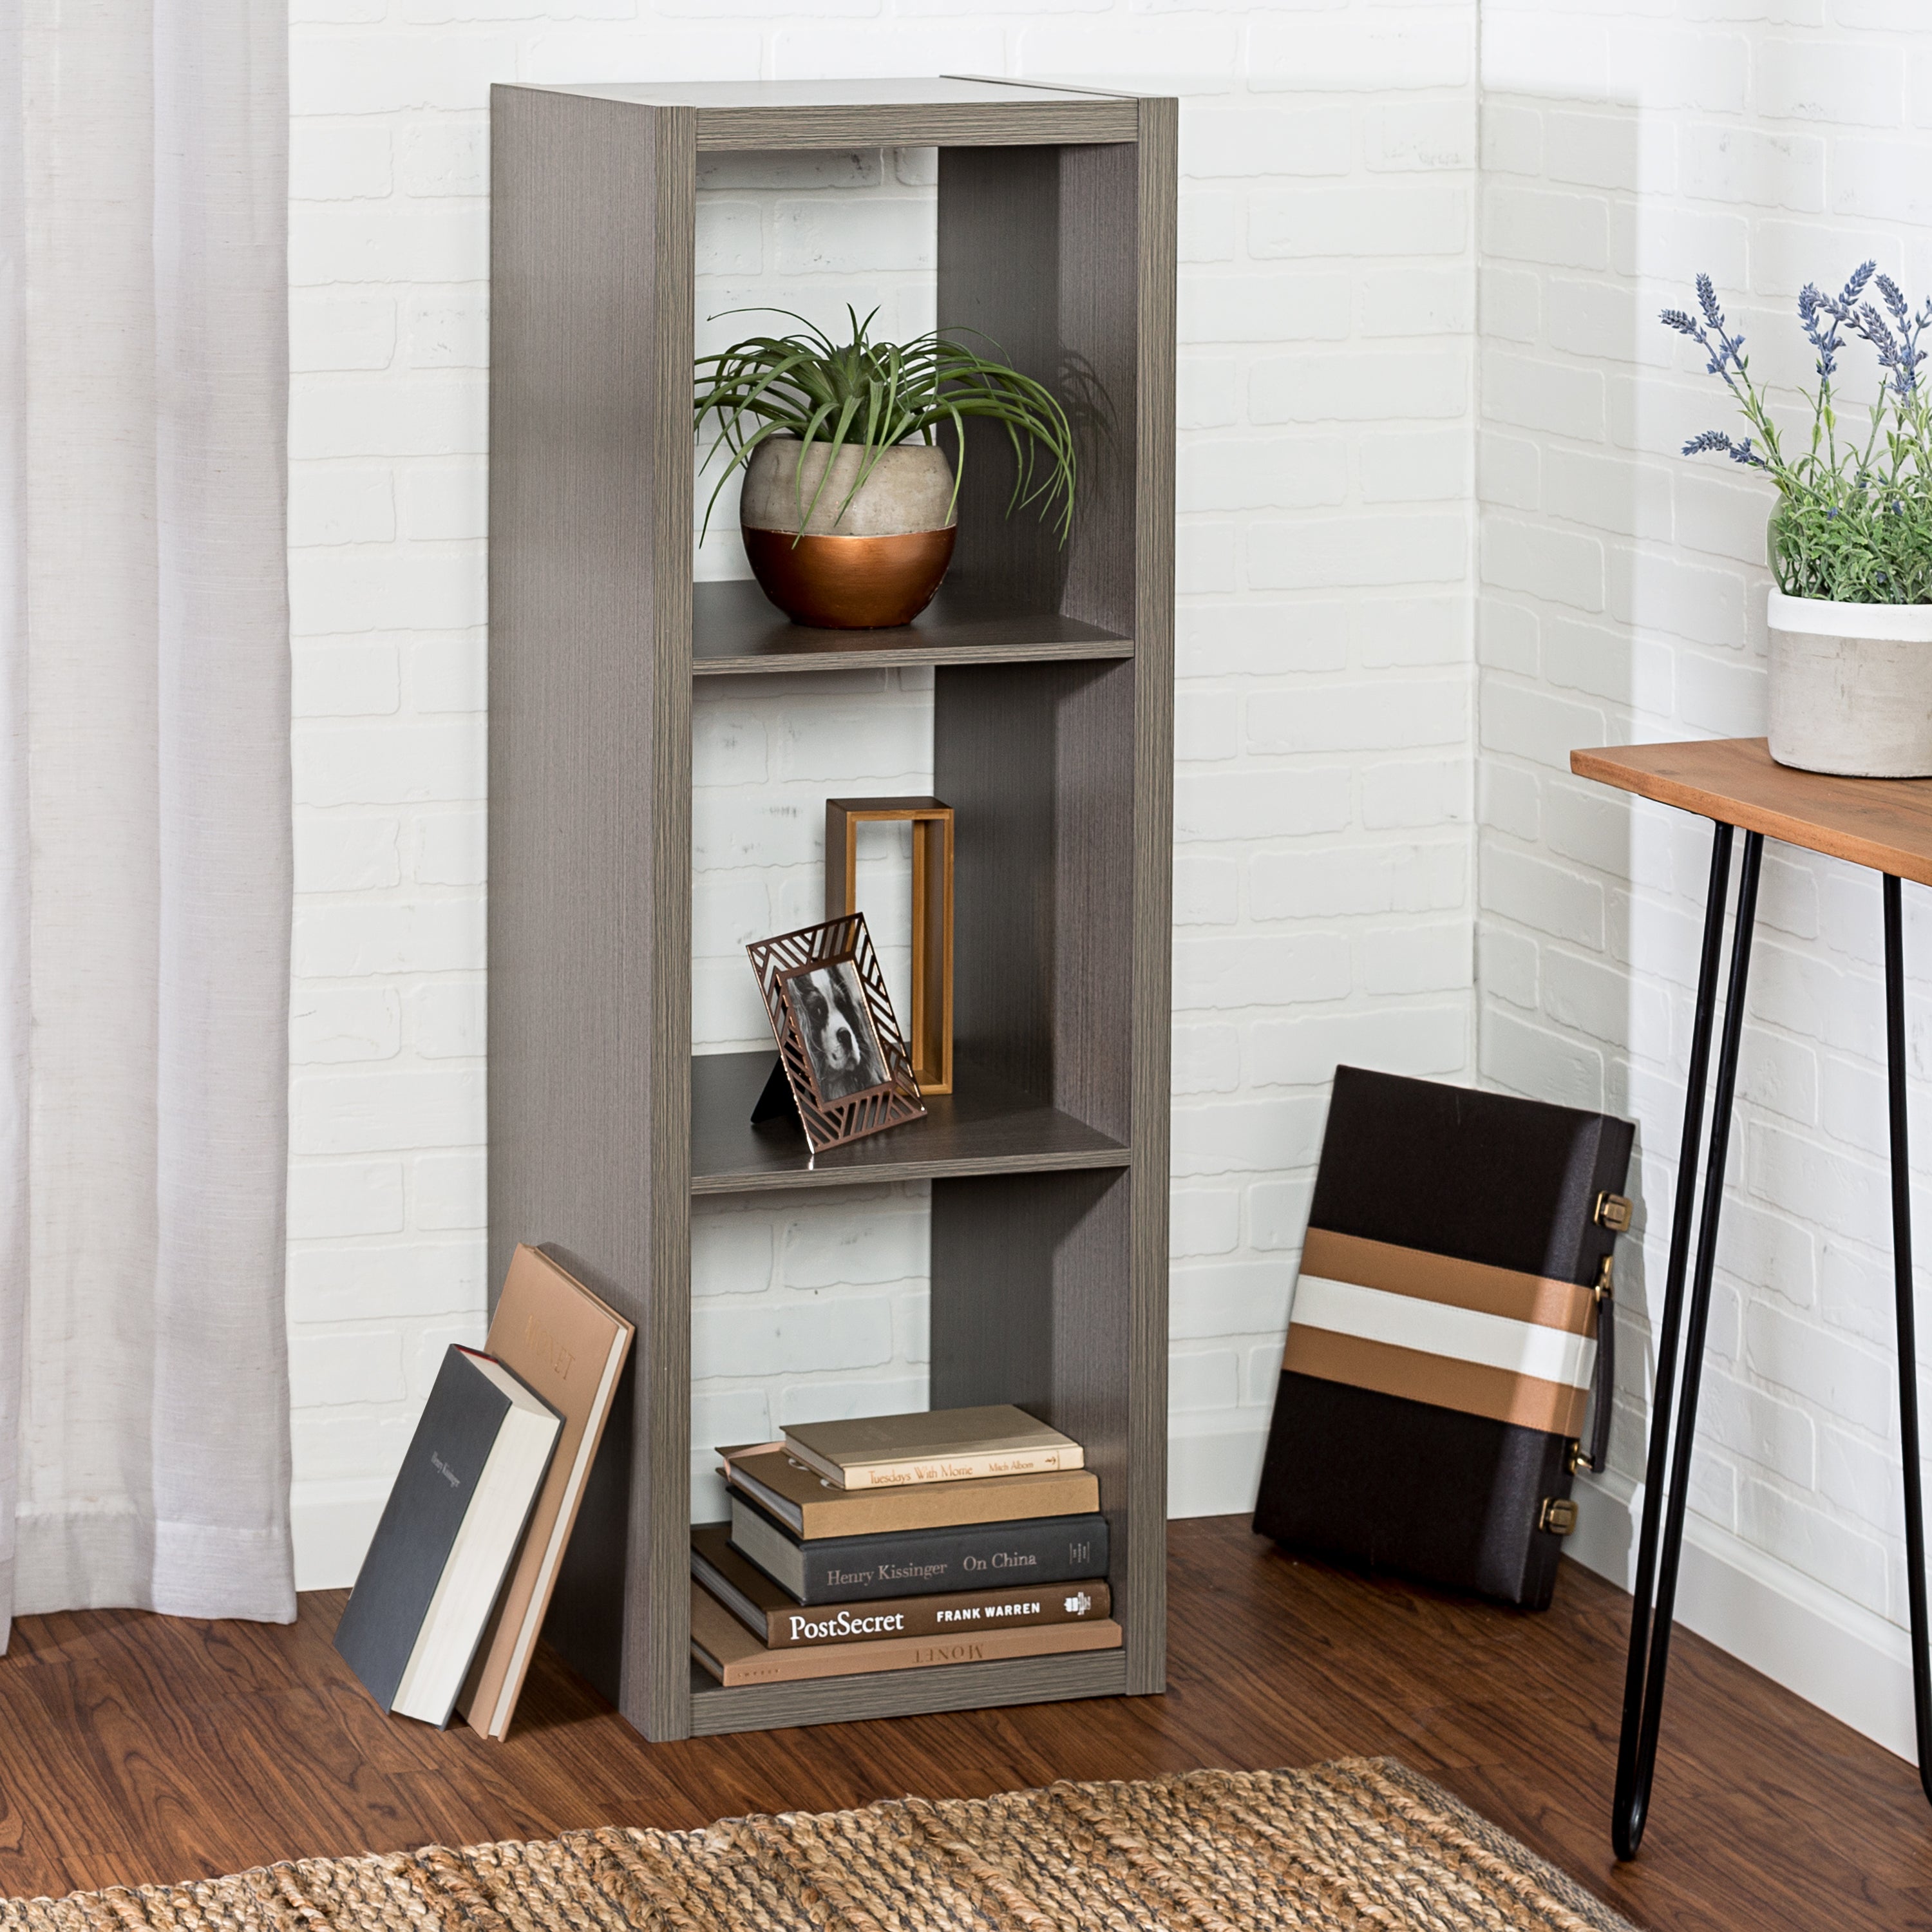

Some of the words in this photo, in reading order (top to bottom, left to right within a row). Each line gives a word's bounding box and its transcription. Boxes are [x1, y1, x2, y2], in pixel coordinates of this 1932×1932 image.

[868, 1468, 911, 1484] Tuesdays
[914, 1466, 938, 1479] With
[827, 1569, 875, 1586] Henry
[878, 1562, 947, 1580] Kissinger
[963, 1556, 987, 1571] On
[992, 1551, 1037, 1568] China
[789, 1611, 904, 1640] PostSecret
[936, 1607, 981, 1622] FRANK
[984, 1602, 1041, 1618] WARREN
[912, 1643, 984, 1663] MONET
